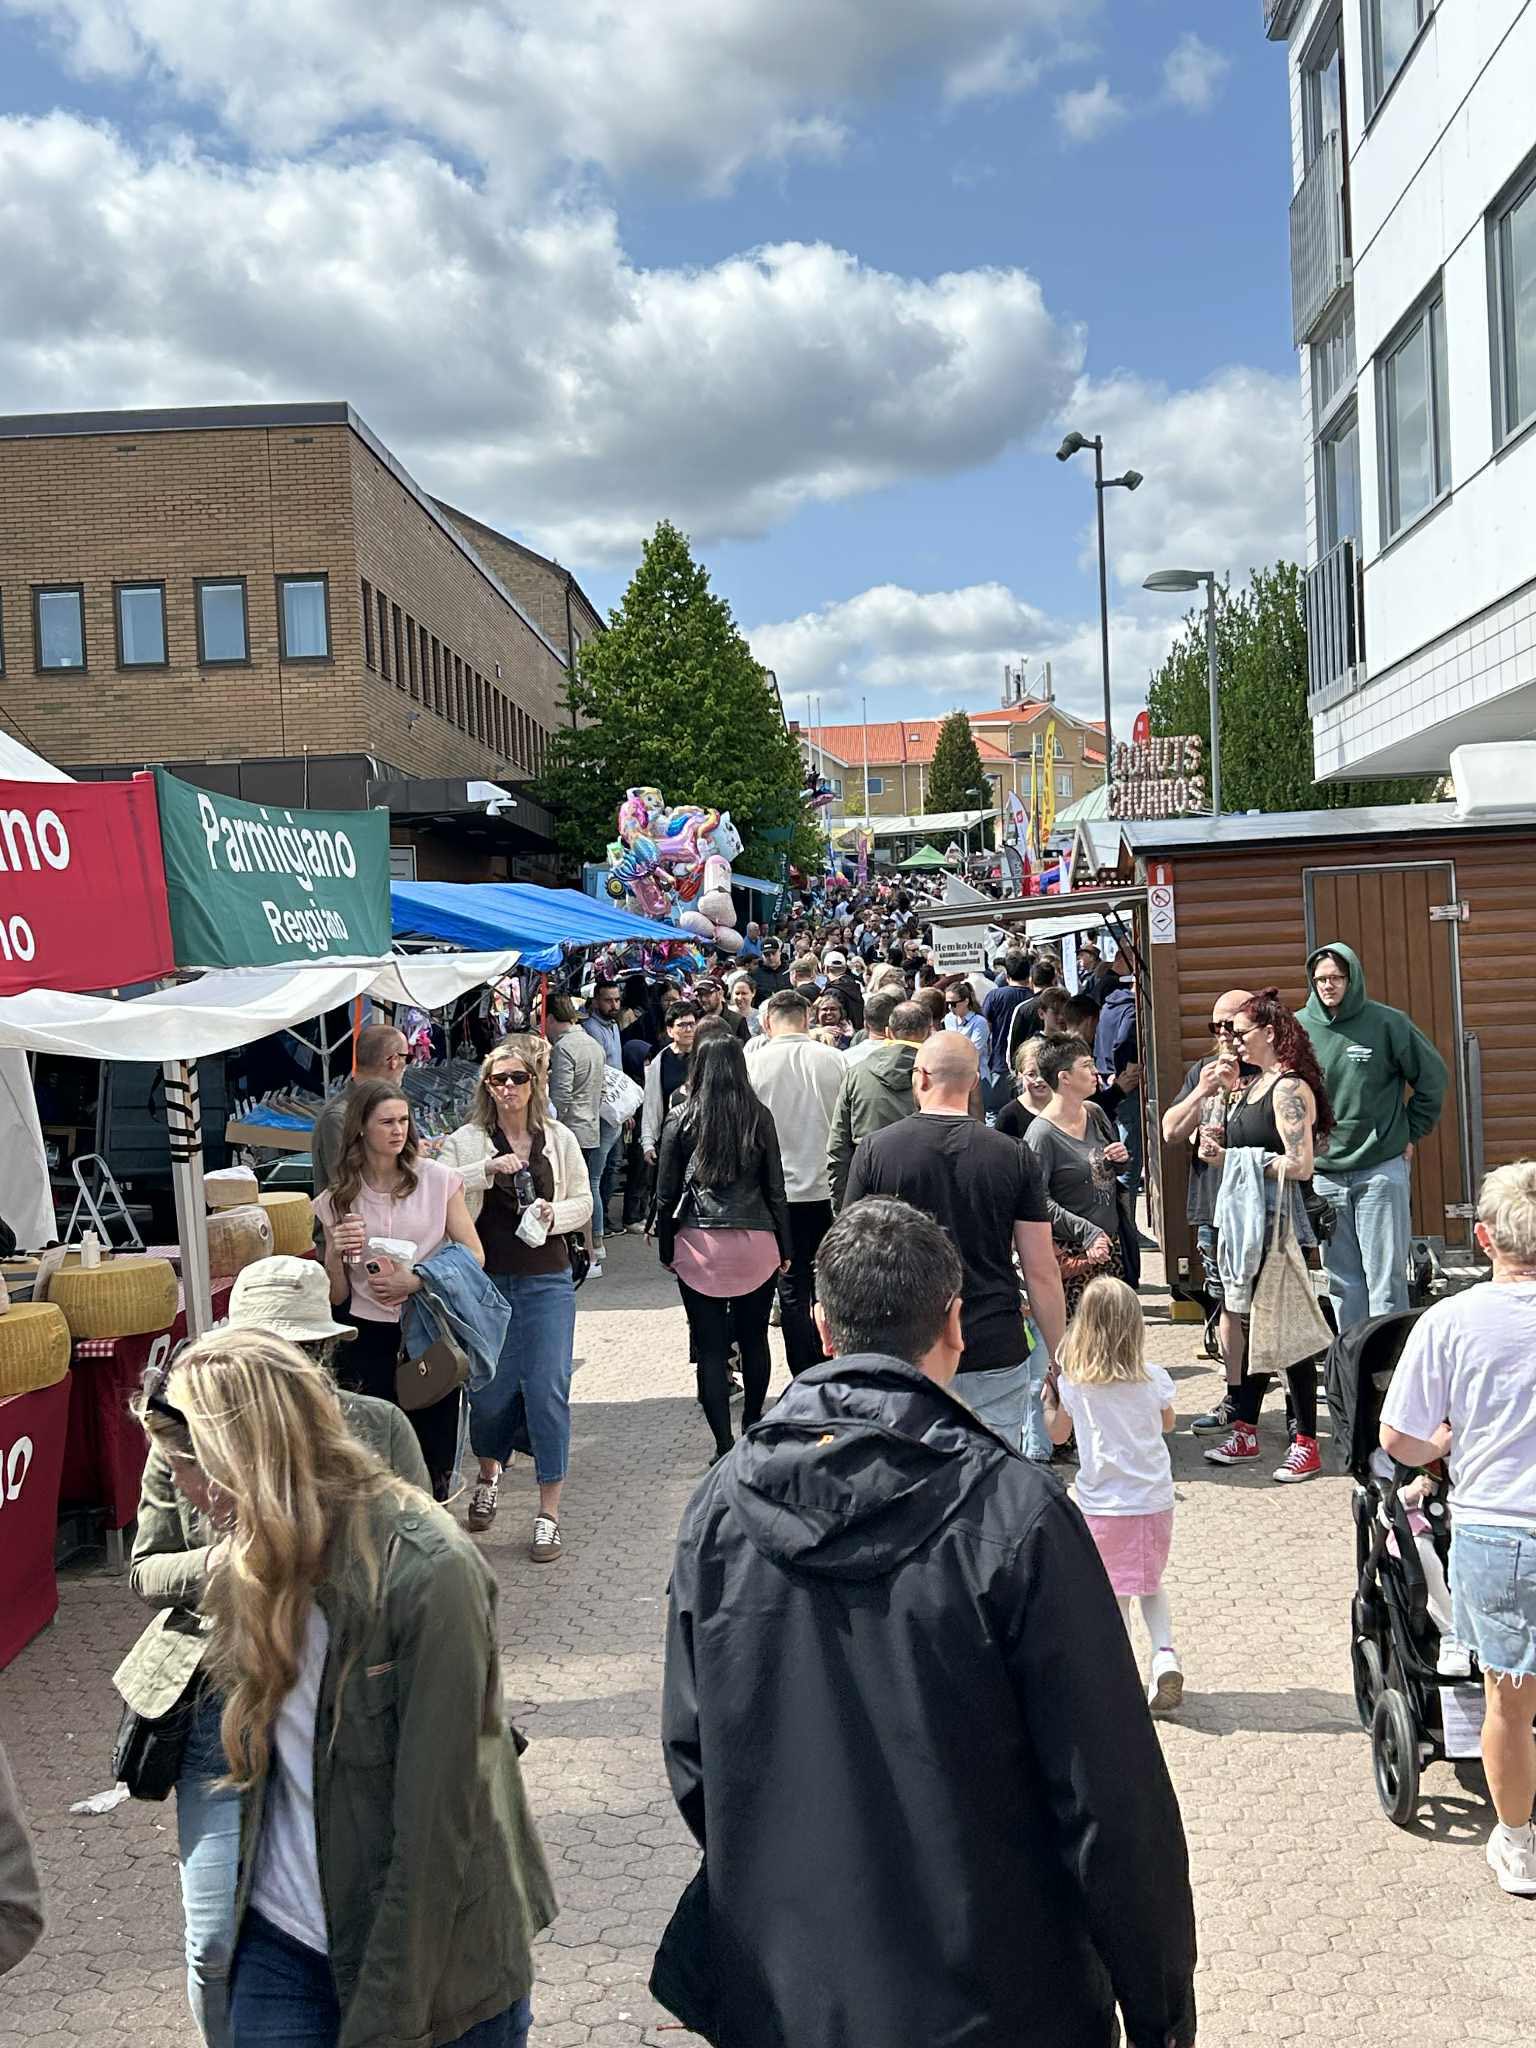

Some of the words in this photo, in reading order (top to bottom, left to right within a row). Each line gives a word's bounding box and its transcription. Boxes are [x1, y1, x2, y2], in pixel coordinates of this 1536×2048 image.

[0, 809, 70, 871] no
[197, 793, 356, 891] Parmigiano
[261, 898, 349, 952] Reggiano
